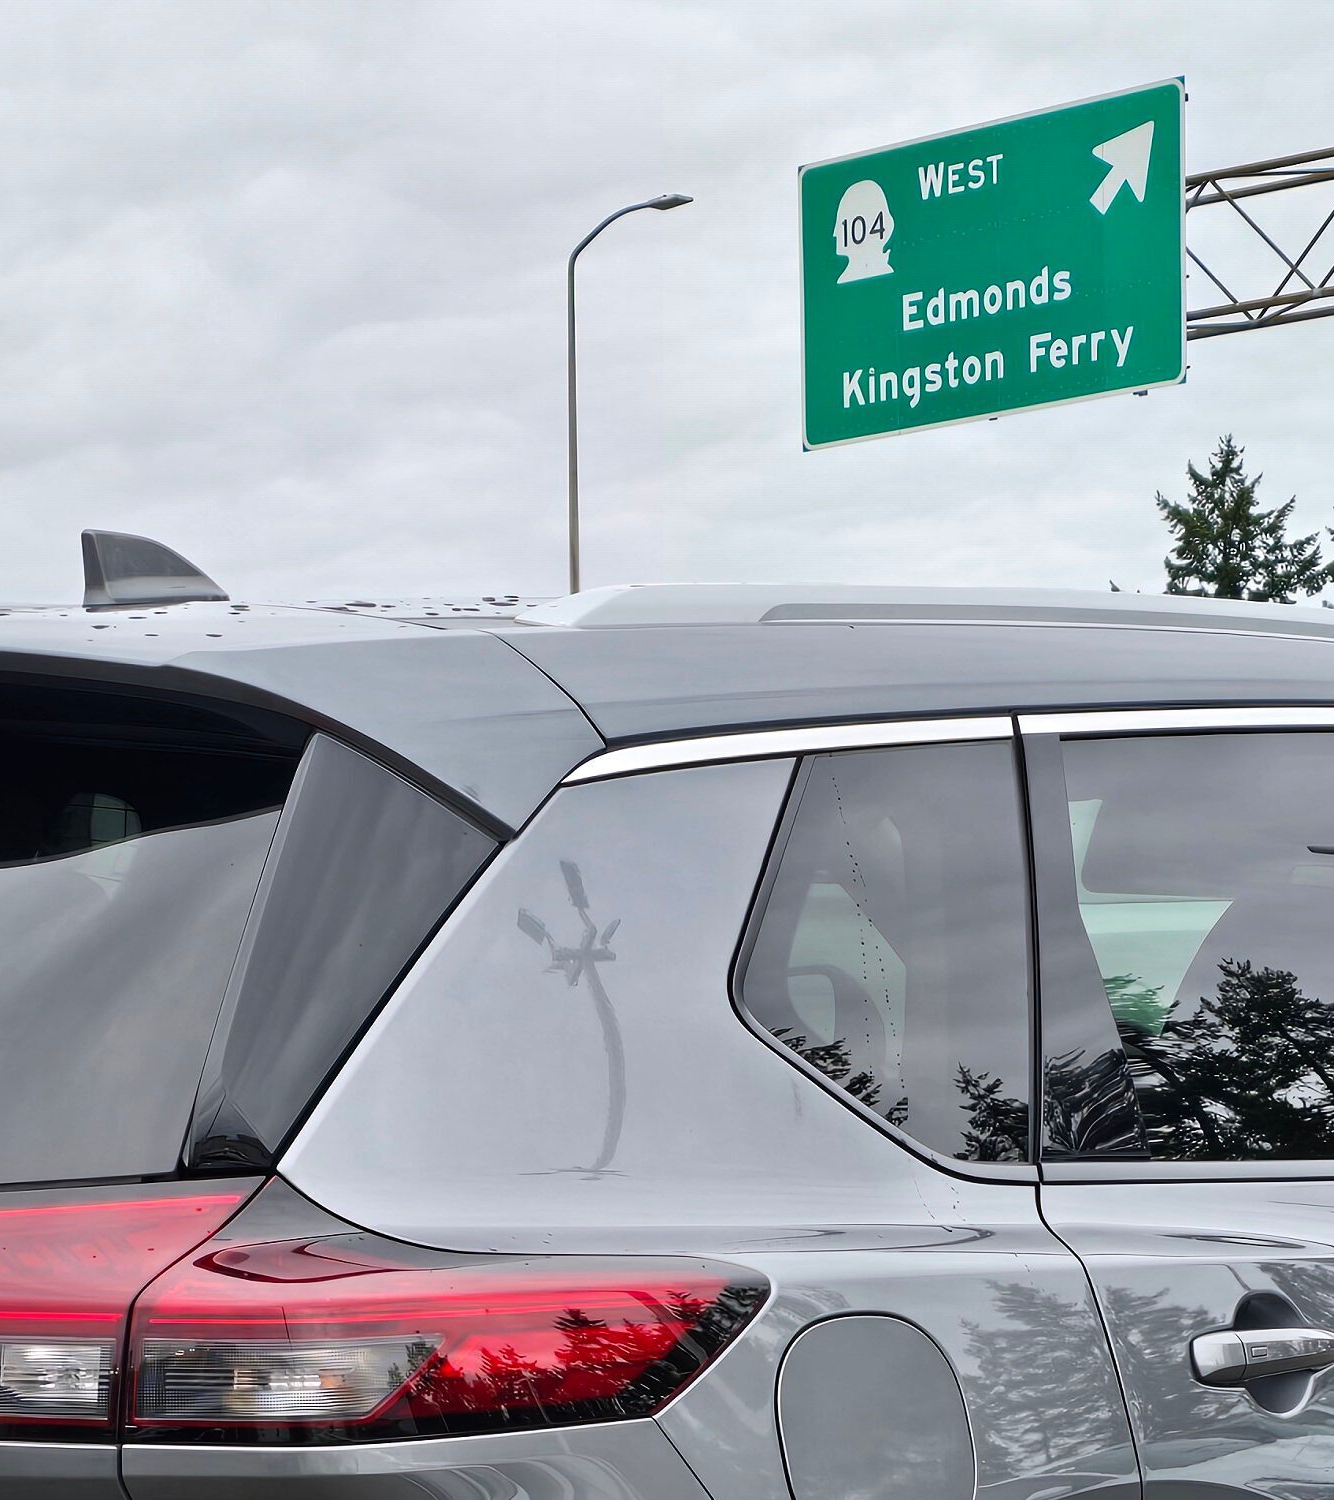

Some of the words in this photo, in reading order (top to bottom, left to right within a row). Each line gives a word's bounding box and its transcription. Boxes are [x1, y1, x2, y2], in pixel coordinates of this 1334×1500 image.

[918, 153, 1004, 201] WEST
[841, 211, 886, 248] 104
[902, 265, 1072, 332] Edmonds
[843, 350, 1004, 408] Kingston
[1029, 326, 1134, 373] Ferry
